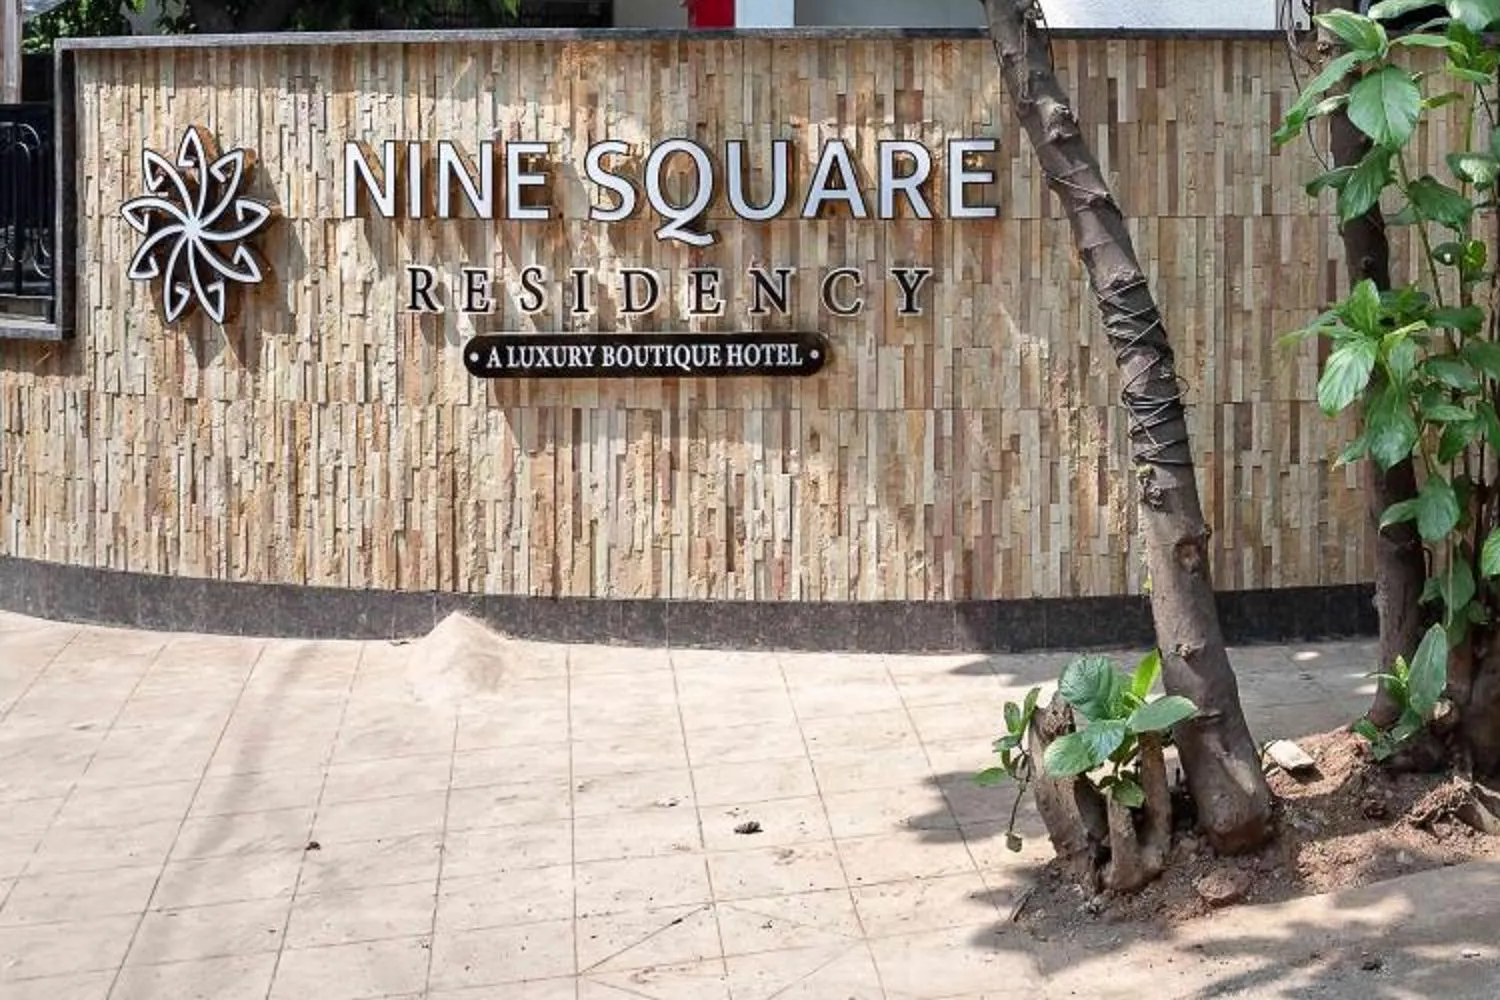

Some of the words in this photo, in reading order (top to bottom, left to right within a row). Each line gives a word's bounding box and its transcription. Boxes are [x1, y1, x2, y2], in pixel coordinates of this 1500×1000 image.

[343, 139, 551, 220] NINE
[583, 138, 1000, 248] SQUARE
[405, 263, 934, 318] RESIDENCY
[486, 347, 502, 369] A
[506, 345, 596, 369] LUXURY
[600, 345, 723, 371] BOUTIQUE
[726, 344, 804, 368] HOTEL
